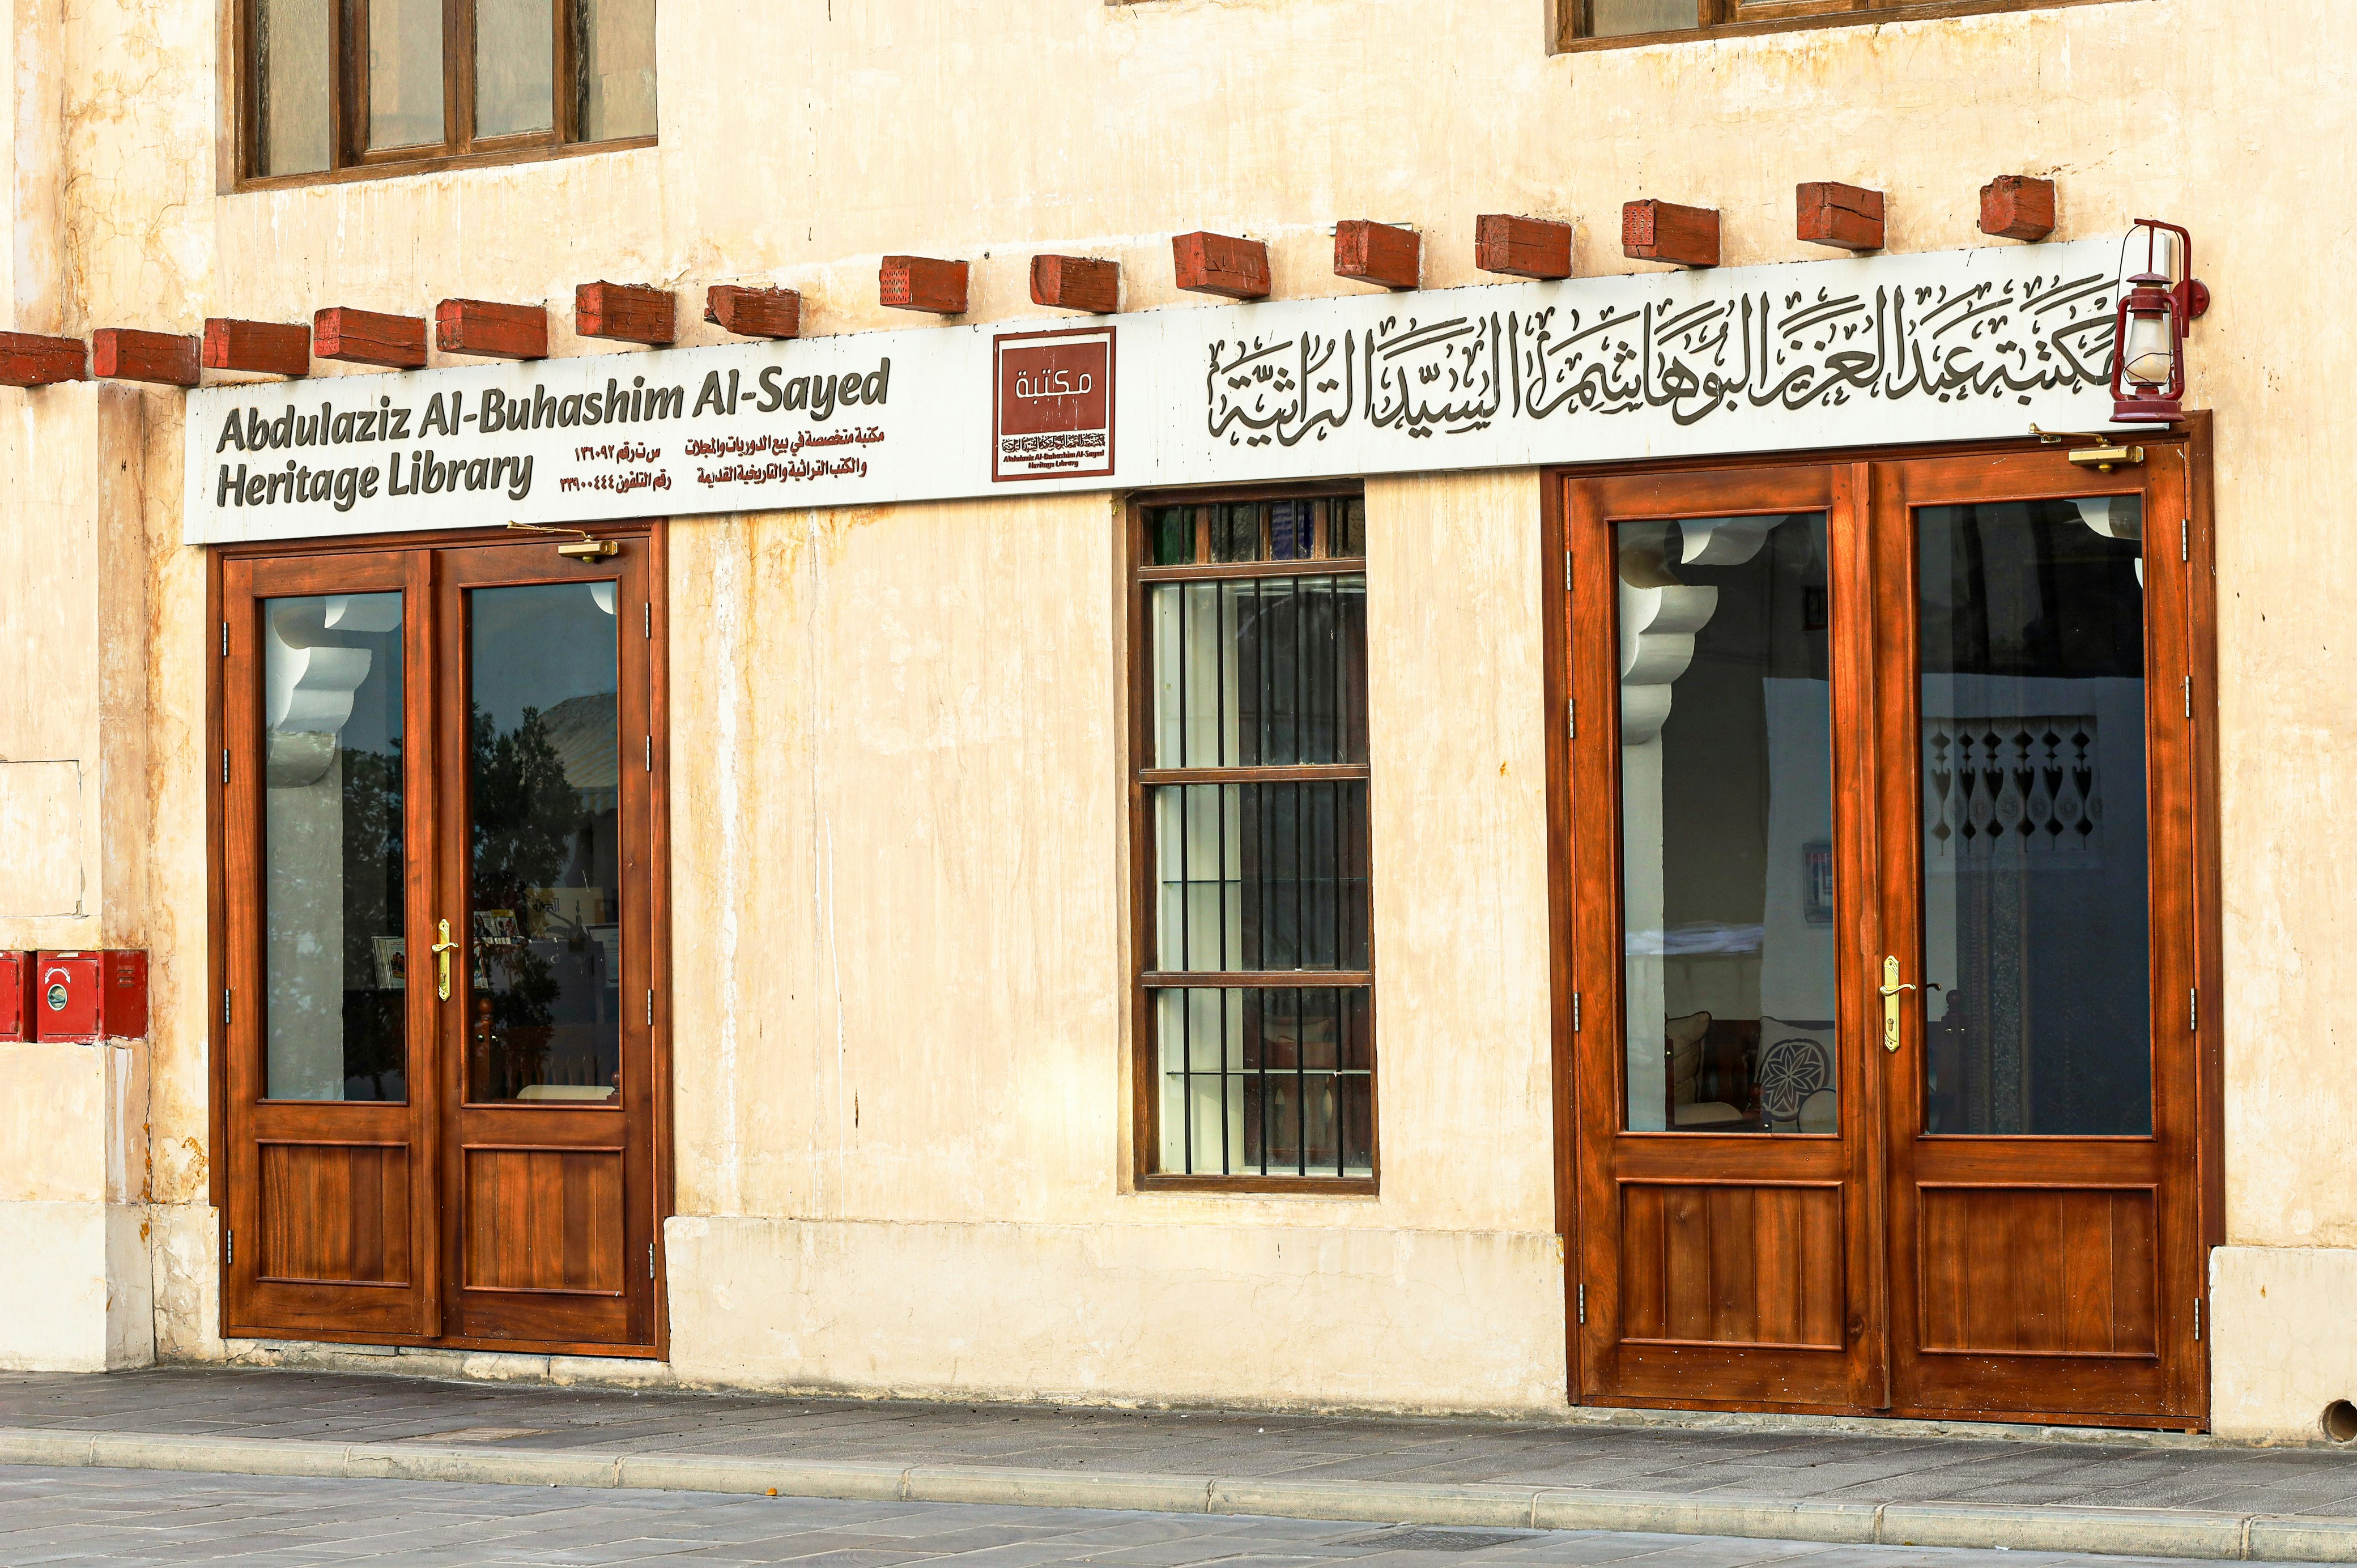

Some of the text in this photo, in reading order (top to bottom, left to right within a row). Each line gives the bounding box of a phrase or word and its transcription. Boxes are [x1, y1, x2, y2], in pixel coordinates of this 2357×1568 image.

[1015, 369, 1092, 405] مكتبة
[216, 357, 891, 454] Abdulaziz Al-Buhashim Al-Sayed
[575, 445, 615, 462] ١٣٦٠٩٢
[616, 441, 635, 464] رقم
[684, 426, 885, 458] مكتبة متخصصة في بيع الدوريات والمجلات
[217, 450, 533, 512] Heritage Library
[615, 470, 652, 494] التلفون
[653, 468, 672, 492] رقم
[697, 457, 867, 488] والكتب التراثية والتاريخية القديمة
